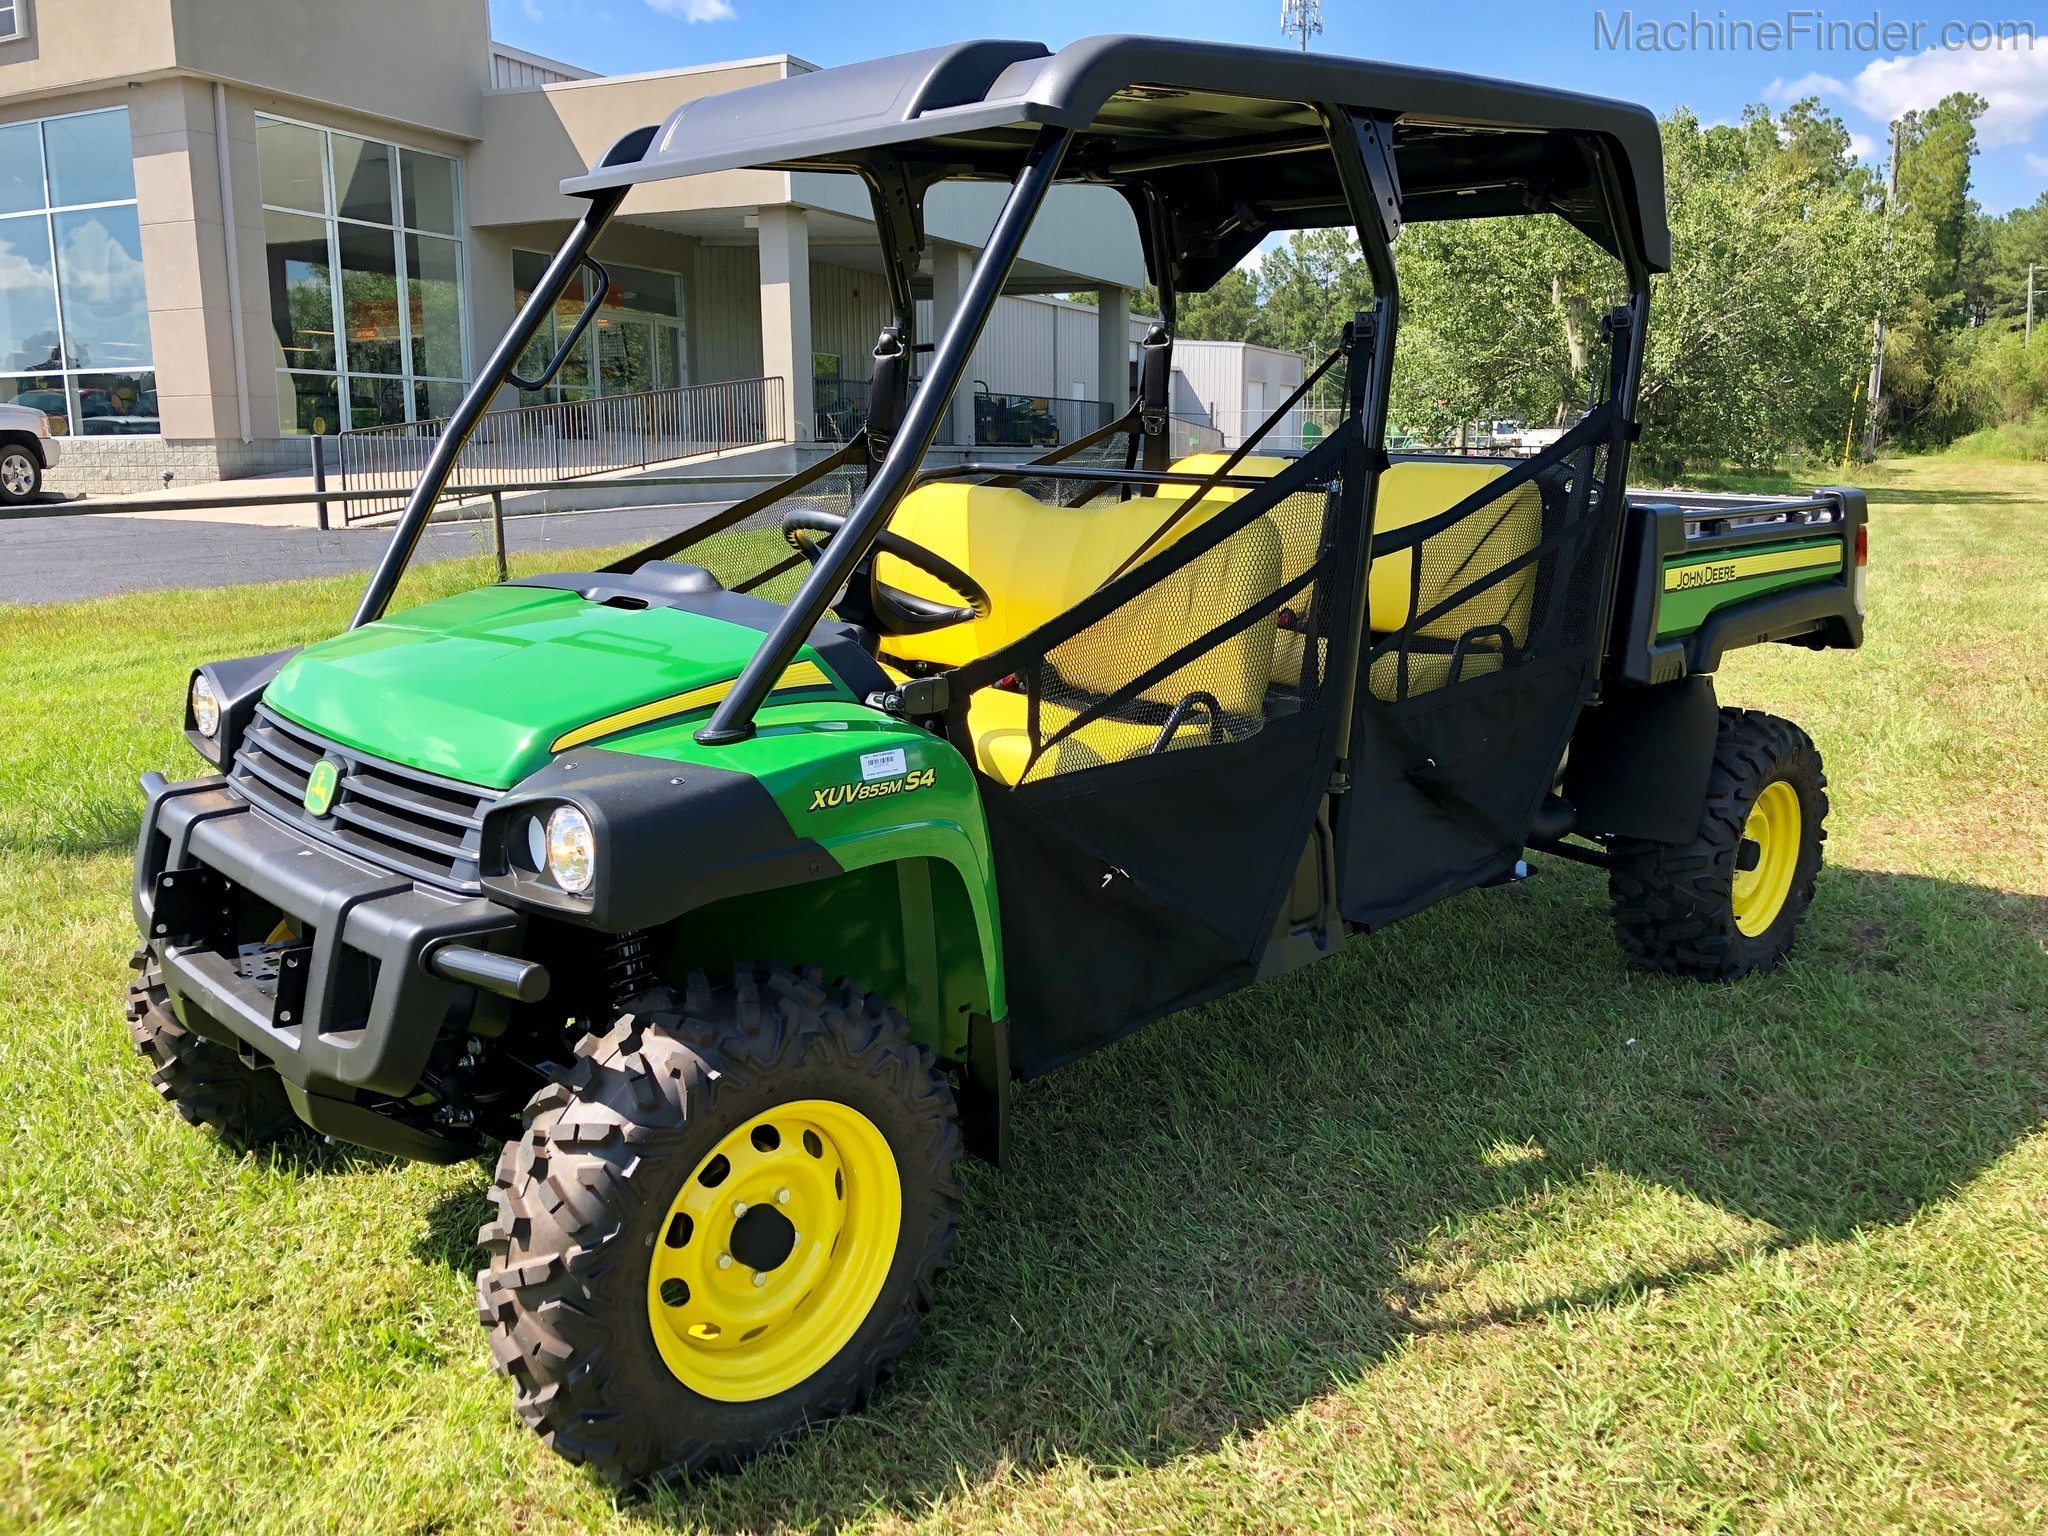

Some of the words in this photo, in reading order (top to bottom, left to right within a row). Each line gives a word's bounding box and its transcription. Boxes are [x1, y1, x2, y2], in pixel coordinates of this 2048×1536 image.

[1677, 569, 1704, 588] JOHN
[1705, 565, 1736, 584] DEERE
[808, 779, 904, 811] XUV855M
[904, 768, 936, 791] S4
